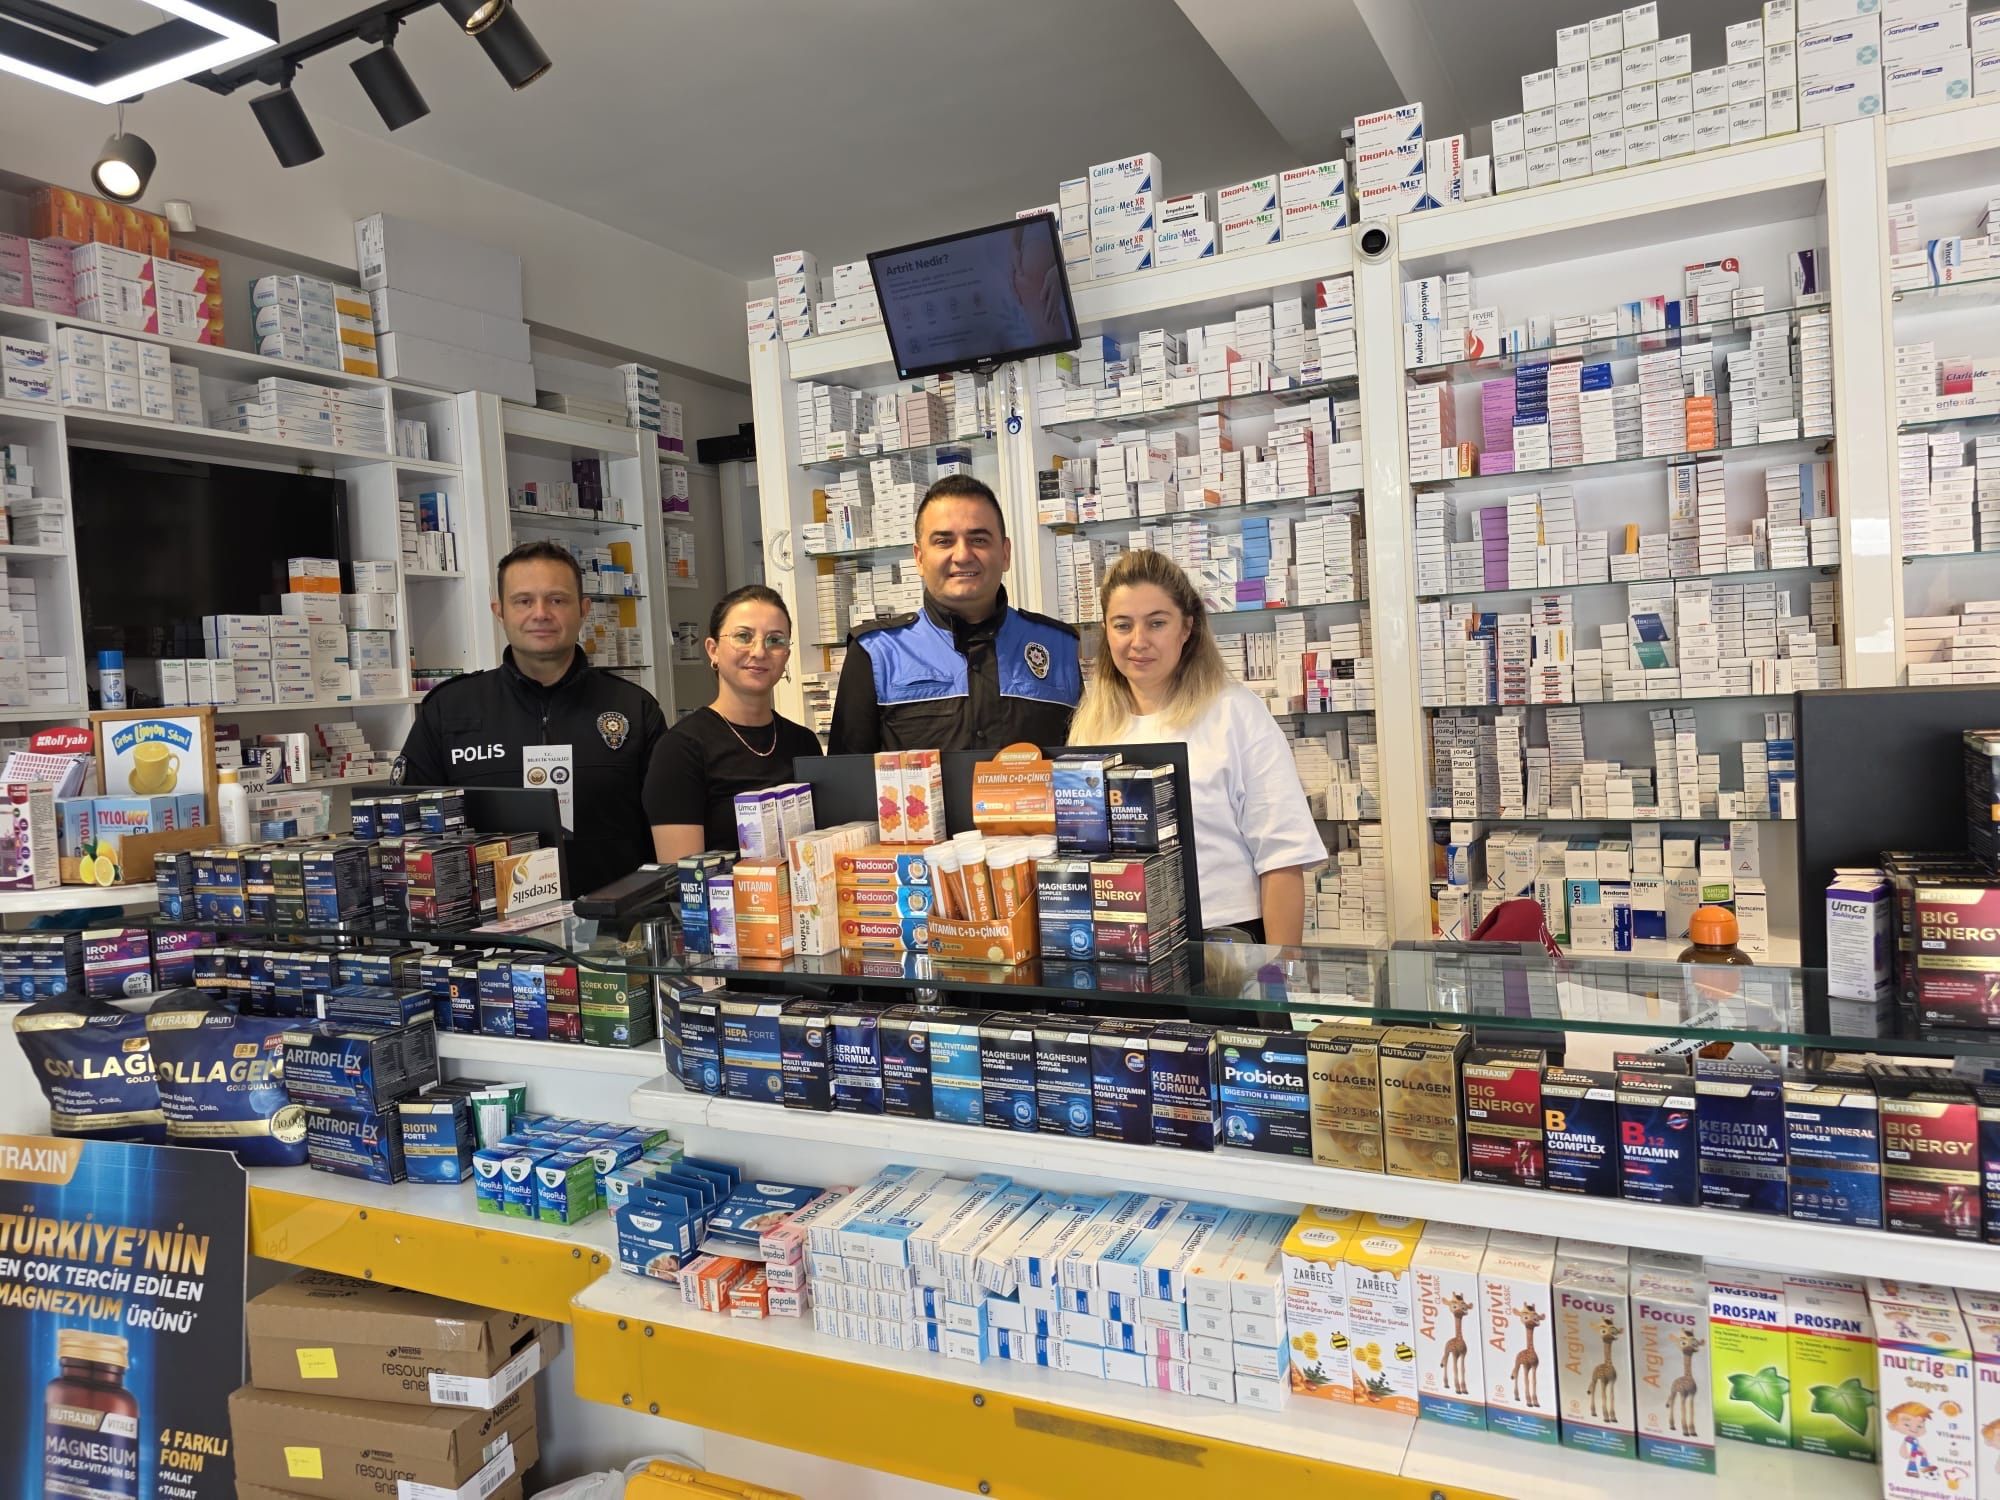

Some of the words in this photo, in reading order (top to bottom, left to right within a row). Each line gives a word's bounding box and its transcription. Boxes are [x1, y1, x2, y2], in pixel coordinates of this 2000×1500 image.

[1134, 158, 1143, 168] XR
[1135, 196, 1145, 207] XR
[1134, 234, 1143, 245] XR
[886, 260, 914, 276] Artrit
[916, 254, 949, 269] Nedir?
[1725, 260, 1731, 270] 6
[1420, 281, 1428, 321] Multicold
[1415, 323, 1423, 364] Multicold
[1055, 788, 1103, 799] OMEGA-3
[1109, 789, 1123, 806] B
[738, 803, 757, 813] Umca
[1111, 806, 1142, 814] VITAMIN
[352, 815, 370, 824] ZINC
[1111, 812, 1149, 822] COMPLEX
[855, 860, 895, 871] Redoxon
[738, 880, 773, 893] VITAMIN
[1038, 882, 1087, 892] MAGNESIUM
[1094, 879, 1114, 890] BIG
[512, 881, 558, 903] Strepsils
[711, 888, 730, 898] Umca
[856, 891, 895, 902] Redoxon
[1094, 890, 1142, 901] ENERGY
[1831, 900, 1867, 914] Umca
[1921, 911, 1959, 925] BIG
[860, 924, 900, 935] Redoxon
[1921, 927, 2000, 941] ENERGY
[156, 933, 187, 944] IRON
[86, 944, 118, 955] IRON
[156, 943, 175, 951] MAX
[86, 953, 105, 962] MAX
[513, 986, 545, 995] OMEGA-3
[546, 987, 576, 996] ENERGY
[680, 1022, 716, 1034] MAGNESIUM
[724, 1026, 748, 1039] HEPA
[749, 1031, 776, 1040] FORTE
[1221, 1034, 1262, 1046] NUTRAXIN
[285, 1048, 362, 1070] ARTROFLEX
[981, 1049, 1031, 1062] MAGNESIUM
[1036, 1051, 1088, 1064] MAGNESIUM
[782, 1065, 811, 1074] COMPLEX
[884, 1069, 913, 1078] COMPLEX
[1466, 1067, 1511, 1078] NUTRAXIN
[126, 1075, 151, 1084] GOLD
[1152, 1070, 1200, 1085] KERATIN
[1224, 1066, 1304, 1088] Probiota
[1312, 1071, 1376, 1086] COLLAGEN
[1094, 1083, 1115, 1093] MULTI
[1115, 1086, 1146, 1096] VITAMIN
[1153, 1080, 1207, 1096] FORMULA
[1384, 1077, 1451, 1093] COLLAGEN
[1468, 1085, 1496, 1098] BIG
[1621, 1080, 1673, 1090] VITAMIN
[1094, 1090, 1128, 1100] COMPLEX
[1543, 1086, 1581, 1097] NUTRAXIN
[1590, 1090, 1612, 1099] VITALS
[1469, 1099, 1535, 1115] ENERGY
[1619, 1095, 1660, 1106] NUTRAXIN
[1668, 1099, 1692, 1108] VITALS
[1545, 1110, 1566, 1131] B
[308, 1115, 379, 1140] ARTROFLEX
[402, 1123, 438, 1133] BIOTIN
[1699, 1119, 1768, 1137] KERATIN
[1824, 1126, 1876, 1139] MINERAL
[1886, 1121, 1922, 1137] BIG
[1546, 1131, 1596, 1145] VITAMIN
[1699, 1130, 1779, 1150] FORMULA
[1789, 1132, 1832, 1142] COMPLEX
[1547, 1141, 1606, 1155] COMPLEX
[1623, 1145, 1679, 1159] VITAMIN
[1886, 1136, 1975, 1156] ENERGY
[476, 1178, 503, 1190] VapoRub
[503, 1183, 532, 1195] VapoRub
[538, 1187, 567, 1201] VapoRub
[793, 1191, 842, 1225] popolin
[1062, 1214, 1090, 1243] Bepanthol
[1890, 1218, 1902, 1227] 60
[1104, 1227, 1137, 1260] Bepanthol
[0, 1257, 21, 1277] EN
[23, 1261, 60, 1282] ÇOK
[65, 1266, 131, 1292] TERCİH
[133, 1274, 204, 1302] EDİLEN
[767, 1269, 793, 1279] popolin
[1293, 1267, 1333, 1285] ZARBEE'S
[1356, 1278, 1398, 1295] ZARBEE'S
[0, 1283, 124, 1321] MAGNEZYUM
[730, 1299, 760, 1308] Panthenol
[769, 1297, 797, 1307] popolin
[1418, 1272, 1436, 1342] Argivit
[1488, 1282, 1507, 1352] Argivit
[1712, 1303, 1778, 1324] PROSPAN
[1794, 1313, 1862, 1333] PROSPAN
[1564, 1311, 1582, 1375] Argivit
[1642, 1326, 1662, 1388] Argivit
[1883, 1354, 1969, 1379] nutrigen
[49, 1406, 97, 1427] NUTRAXIN
[106, 1417, 135, 1433] VITALS
[159, 1428, 171, 1446] 4
[174, 1431, 229, 1457] FARKLI
[46, 1435, 137, 1468] MAGNESIUM
[160, 1449, 204, 1473] FORM
[158, 1471, 193, 1485] +MALAT
